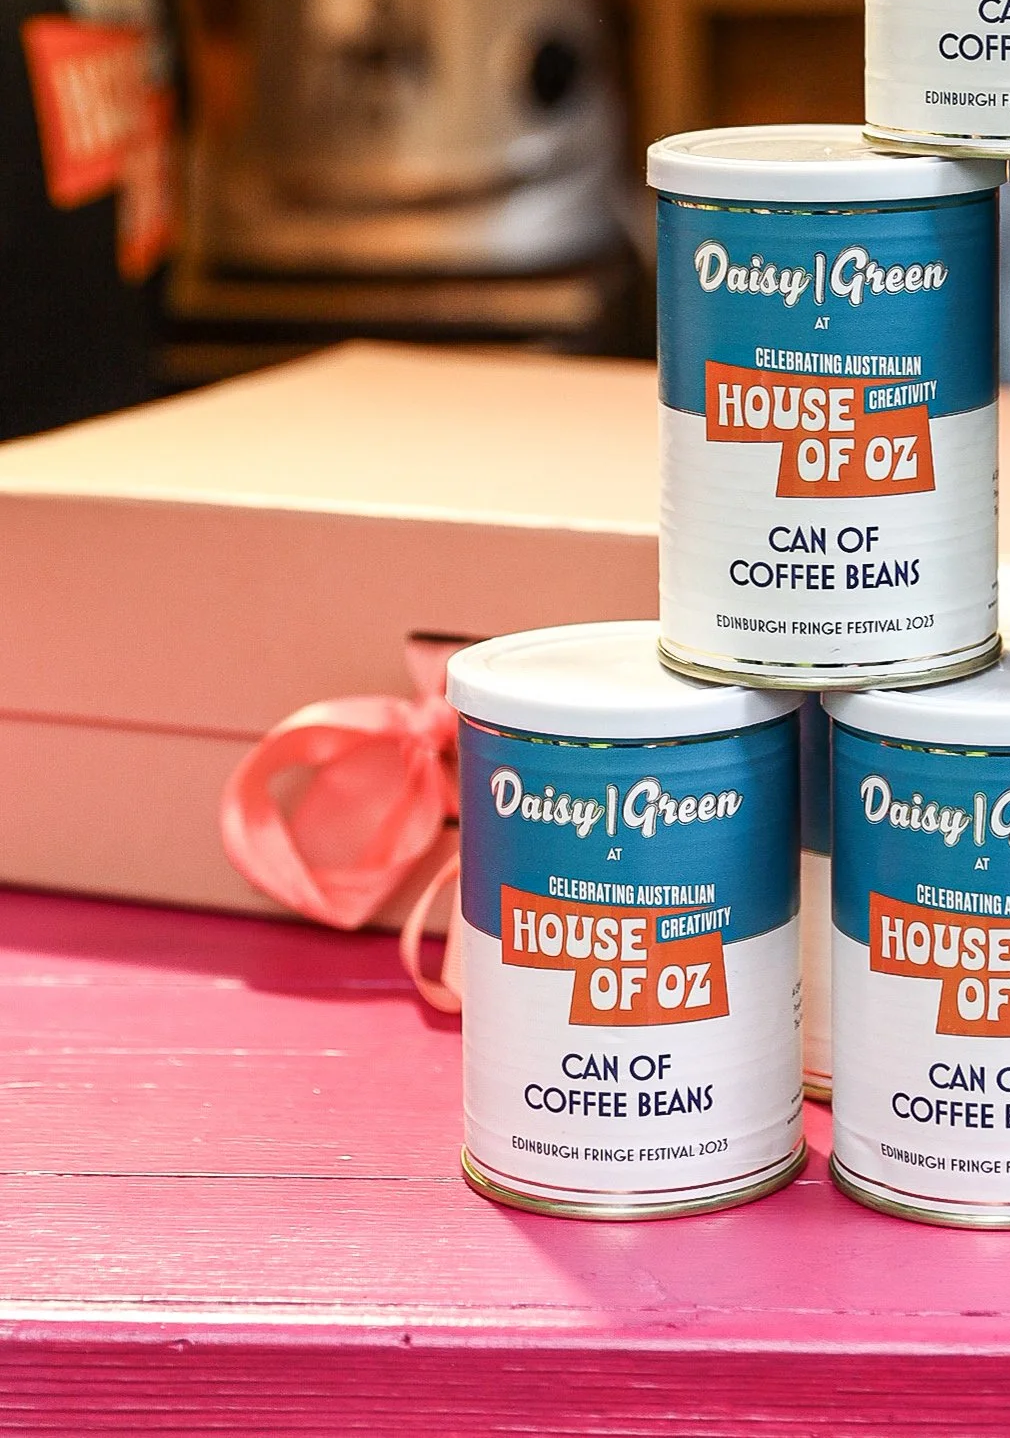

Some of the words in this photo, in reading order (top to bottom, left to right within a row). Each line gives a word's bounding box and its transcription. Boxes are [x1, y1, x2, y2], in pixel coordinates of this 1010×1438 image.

[926, 91, 996, 106] EDINBURGH
[815, 317, 830, 329] AT
[756, 348, 842, 374] CELEBRATING
[845, 355, 921, 375] AUSTRALIAN
[719, 384, 854, 431] HOUSE
[869, 381, 937, 409] CREATIVITY
[798, 439, 854, 481] OF
[865, 436, 917, 480] OZ
[769, 526, 825, 554] CAN
[838, 527, 878, 553] OF
[730, 560, 834, 589] COFFEE
[847, 559, 919, 589] BEANS
[717, 615, 786, 633] EDINBURGH
[793, 622, 841, 635] FRINGE
[848, 619, 902, 634] FESTIVAL
[907, 615, 934, 630] 2023
[607, 848, 622, 860] AT
[975, 858, 990, 870] AT
[550, 876, 634, 904] CELEBRATING
[637, 884, 714, 905] AUSTRALIAN
[917, 884, 1001, 914] CELEBRATING
[514, 909, 647, 961] HOUSE
[662, 907, 731, 939] CREATIVITY
[590, 968, 646, 1010] OF
[658, 963, 710, 1008] OZ
[562, 1054, 618, 1082] CAN
[630, 1054, 671, 1081] OF
[929, 1063, 984, 1093] CAN
[525, 1084, 626, 1117] COFFEE
[639, 1085, 712, 1117] BEANS
[892, 1093, 993, 1128] COFFEE
[512, 1136, 578, 1159] EDINBURGH
[585, 1148, 633, 1161] FRINGE
[640, 1145, 695, 1161] FESTIVAL
[699, 1138, 728, 1155] 2023
[881, 1143, 945, 1170] EDINBURGH
[952, 1159, 1000, 1173] FRINGE
